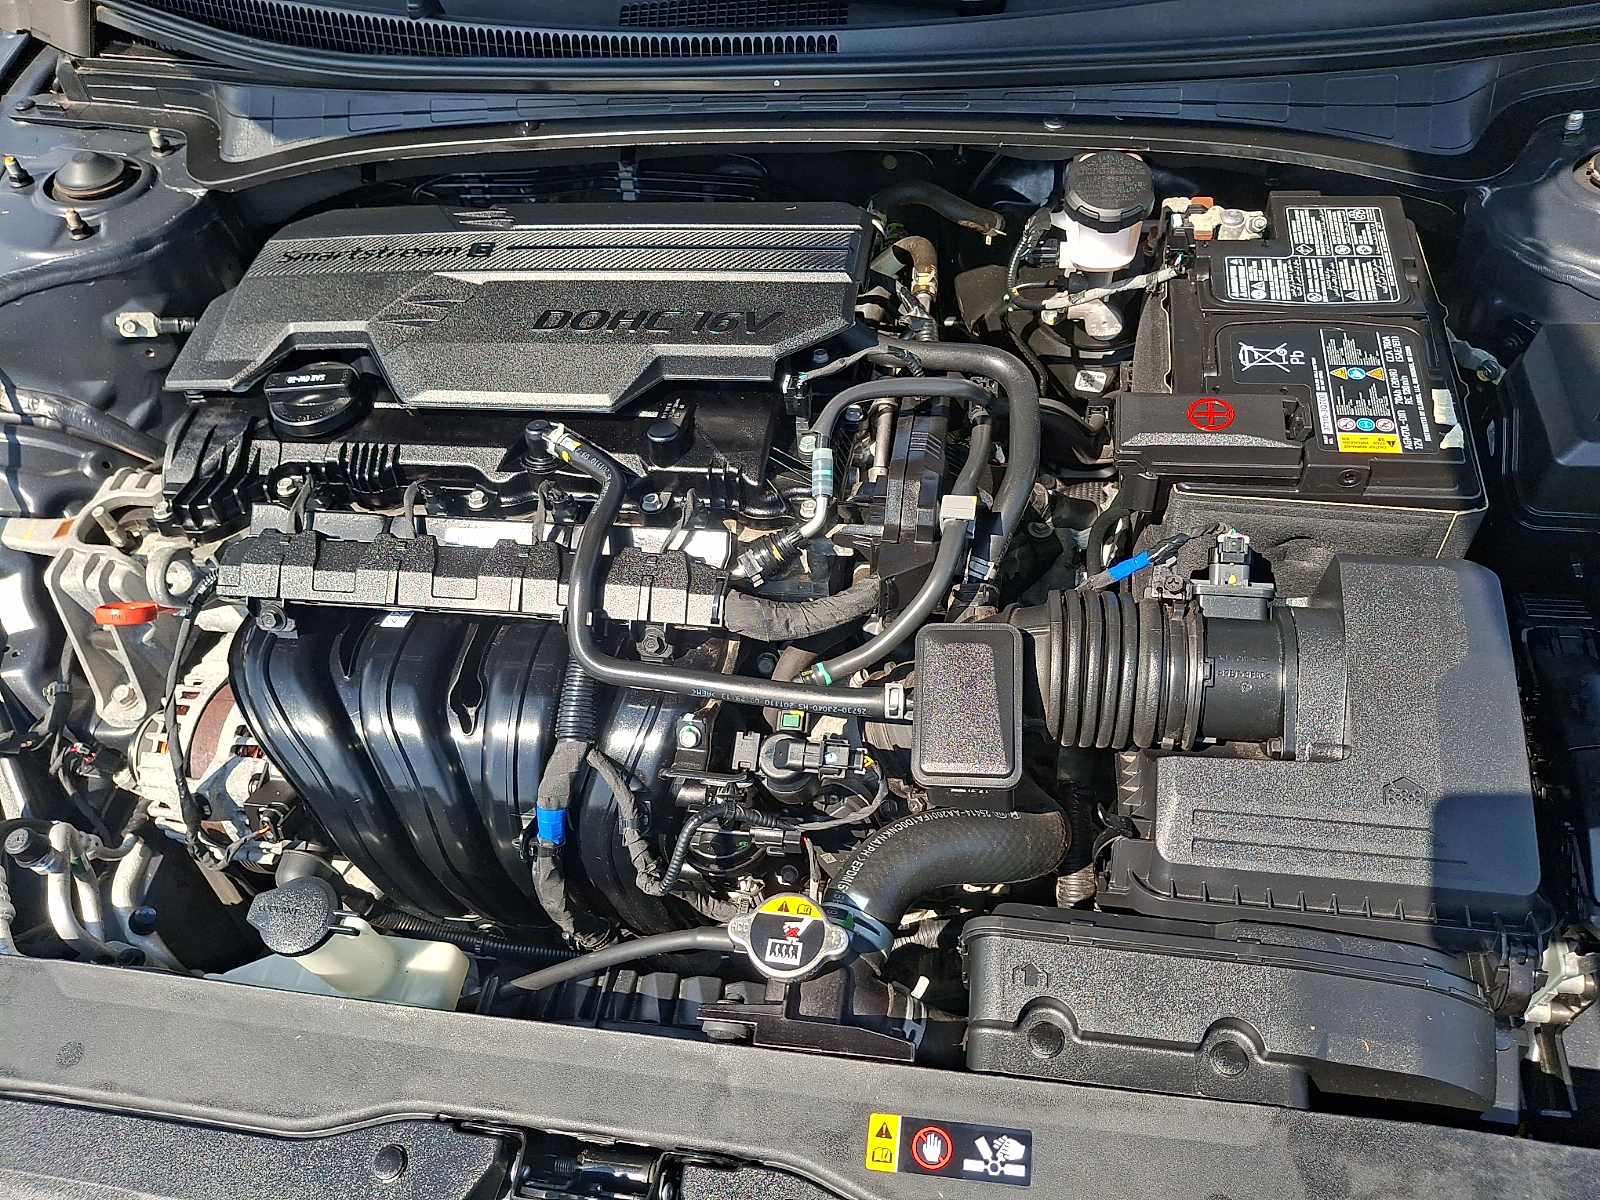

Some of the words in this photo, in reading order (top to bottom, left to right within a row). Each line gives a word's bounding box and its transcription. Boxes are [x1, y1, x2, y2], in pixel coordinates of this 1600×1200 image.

[278, 245, 462, 264] Smartstream
[531, 309, 684, 332] DOHC
[691, 310, 786, 335] 16V
[1289, 350, 1305, 365] Pb
[1412, 437, 1424, 450] 12V
[812, 704, 868, 715] 26730-2J040
